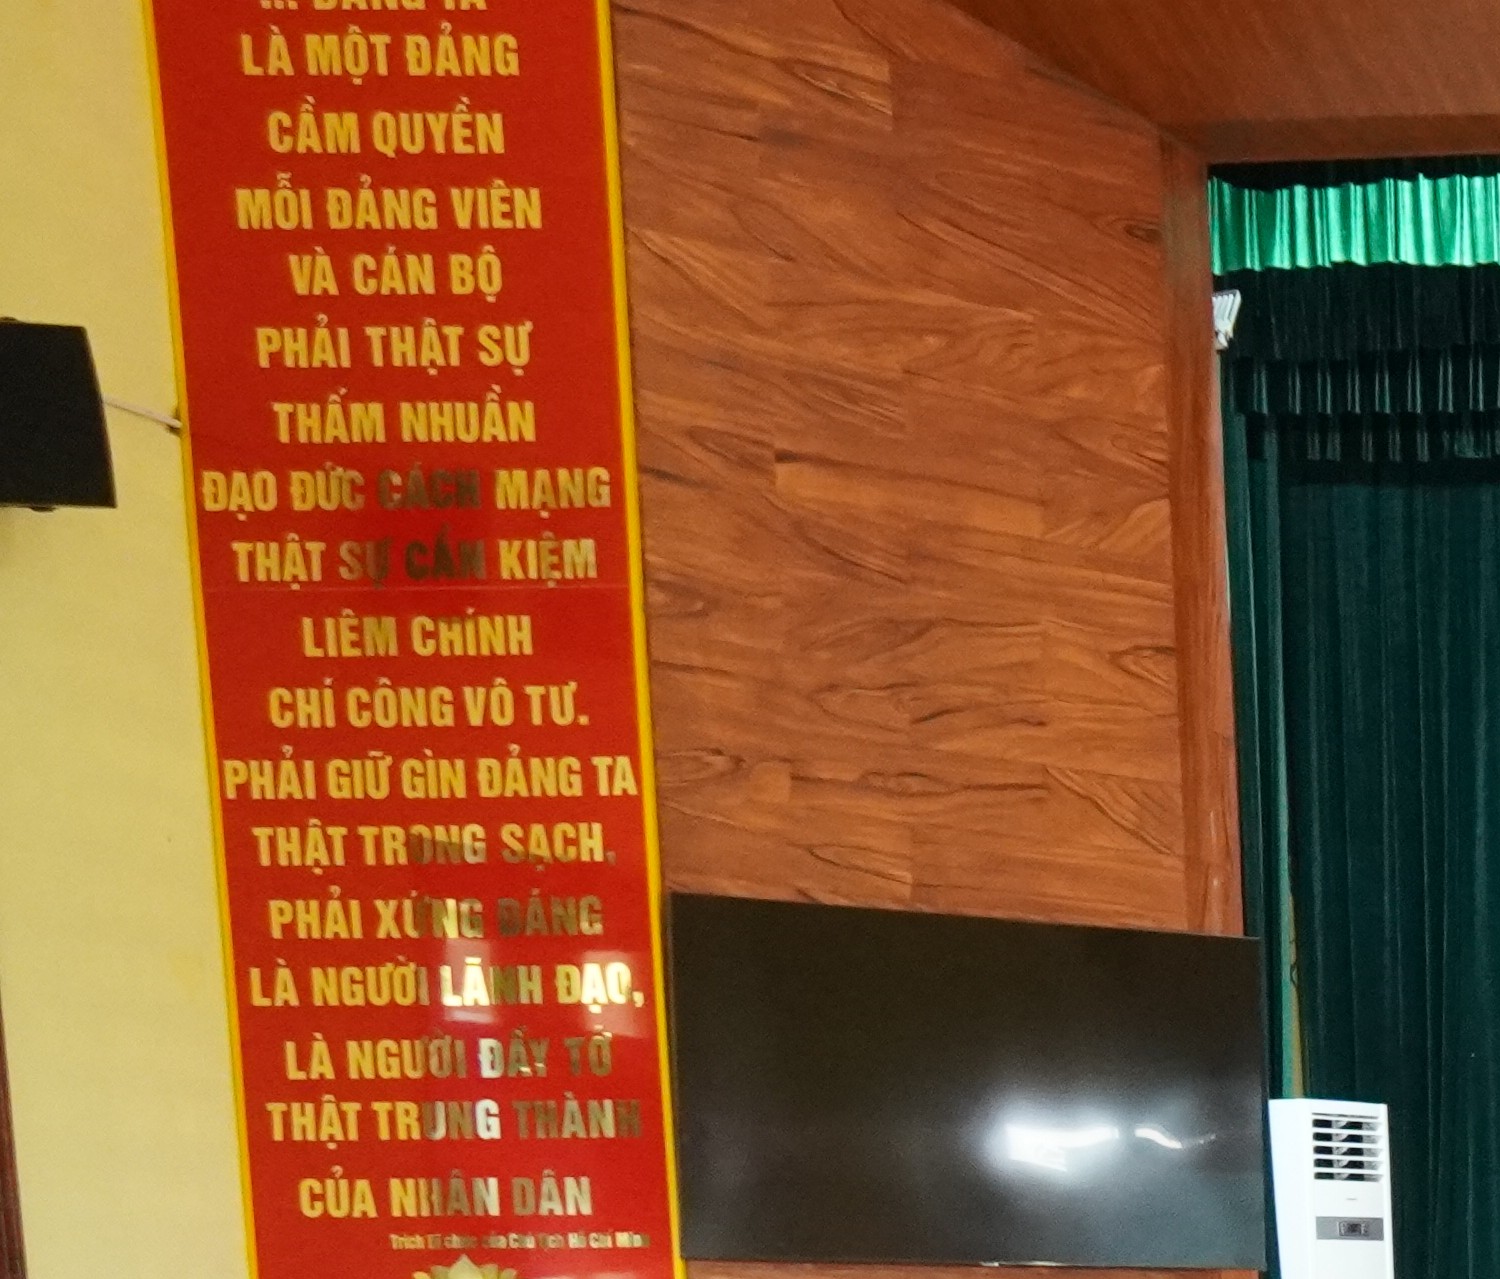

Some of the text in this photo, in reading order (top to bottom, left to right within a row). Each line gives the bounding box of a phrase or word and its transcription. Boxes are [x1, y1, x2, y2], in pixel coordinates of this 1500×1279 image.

[240, 22, 519, 85] LÀ MỘT ĐẢNG
[267, 96, 505, 156] CẦM QUYỀN
[235, 173, 542, 230] MỖI ĐẢNG VIÊN
[289, 245, 502, 302] VÀ CÁN BỘ
[256, 313, 533, 375] PHẢI THẬT SỰ
[302, 608, 398, 658] LIÊM
[223, 745, 637, 800] PHẢI GIỮ GÌN ĐẢNG TA
[270, 887, 602, 939] PHẢI XỨNG ĐÁNG
[249, 956, 644, 1014] LÀ NGƯỜI LÃNH ĐẠO,
[266, 1096, 641, 1150] THẬT TRUNG THÀNH
[298, 1166, 592, 1219] CỦA NHÂN DÂN
